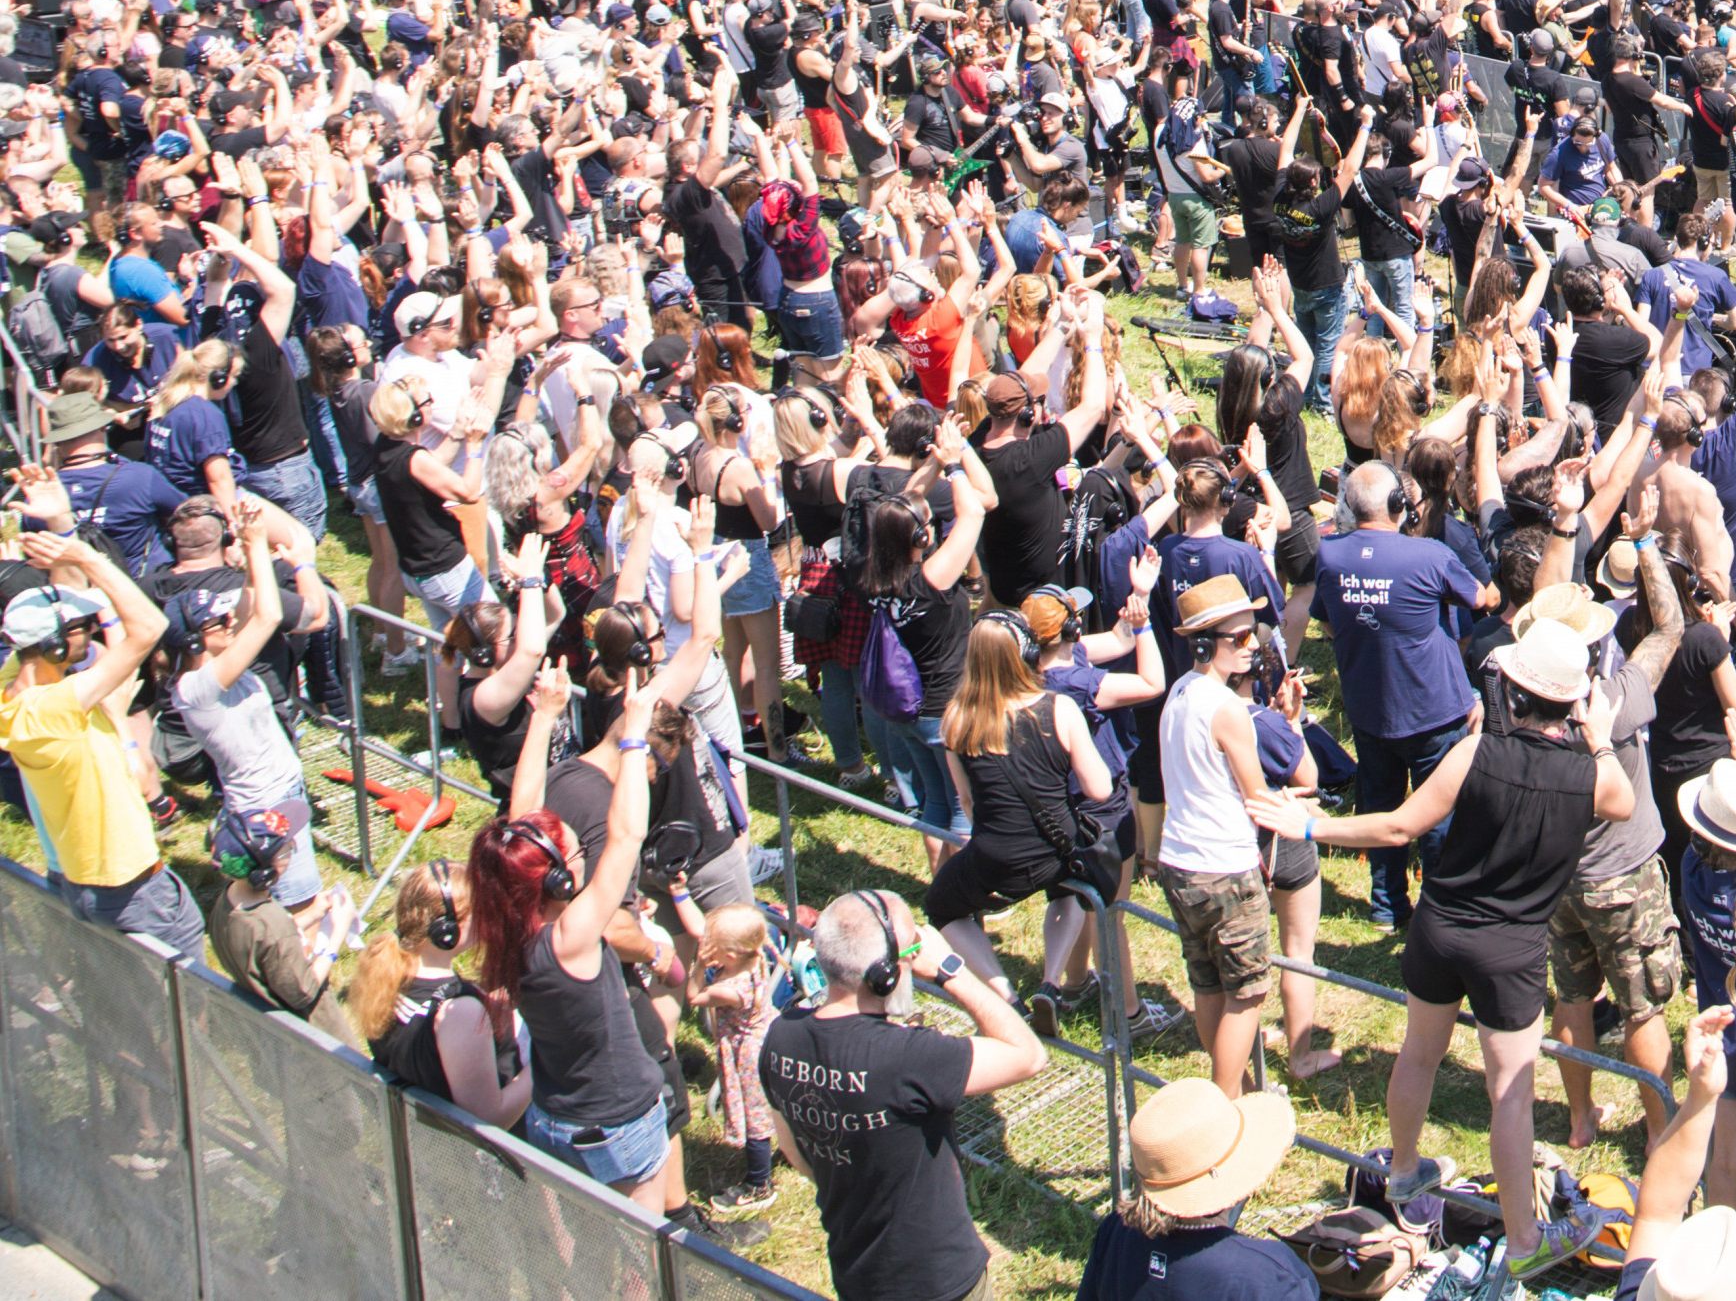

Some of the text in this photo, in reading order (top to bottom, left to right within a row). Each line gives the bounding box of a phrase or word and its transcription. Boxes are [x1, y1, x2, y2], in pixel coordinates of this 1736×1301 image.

[1340, 573, 1393, 590] Ich war
[1342, 589, 1389, 605] dabei!
[770, 1051, 868, 1093] REBORN
